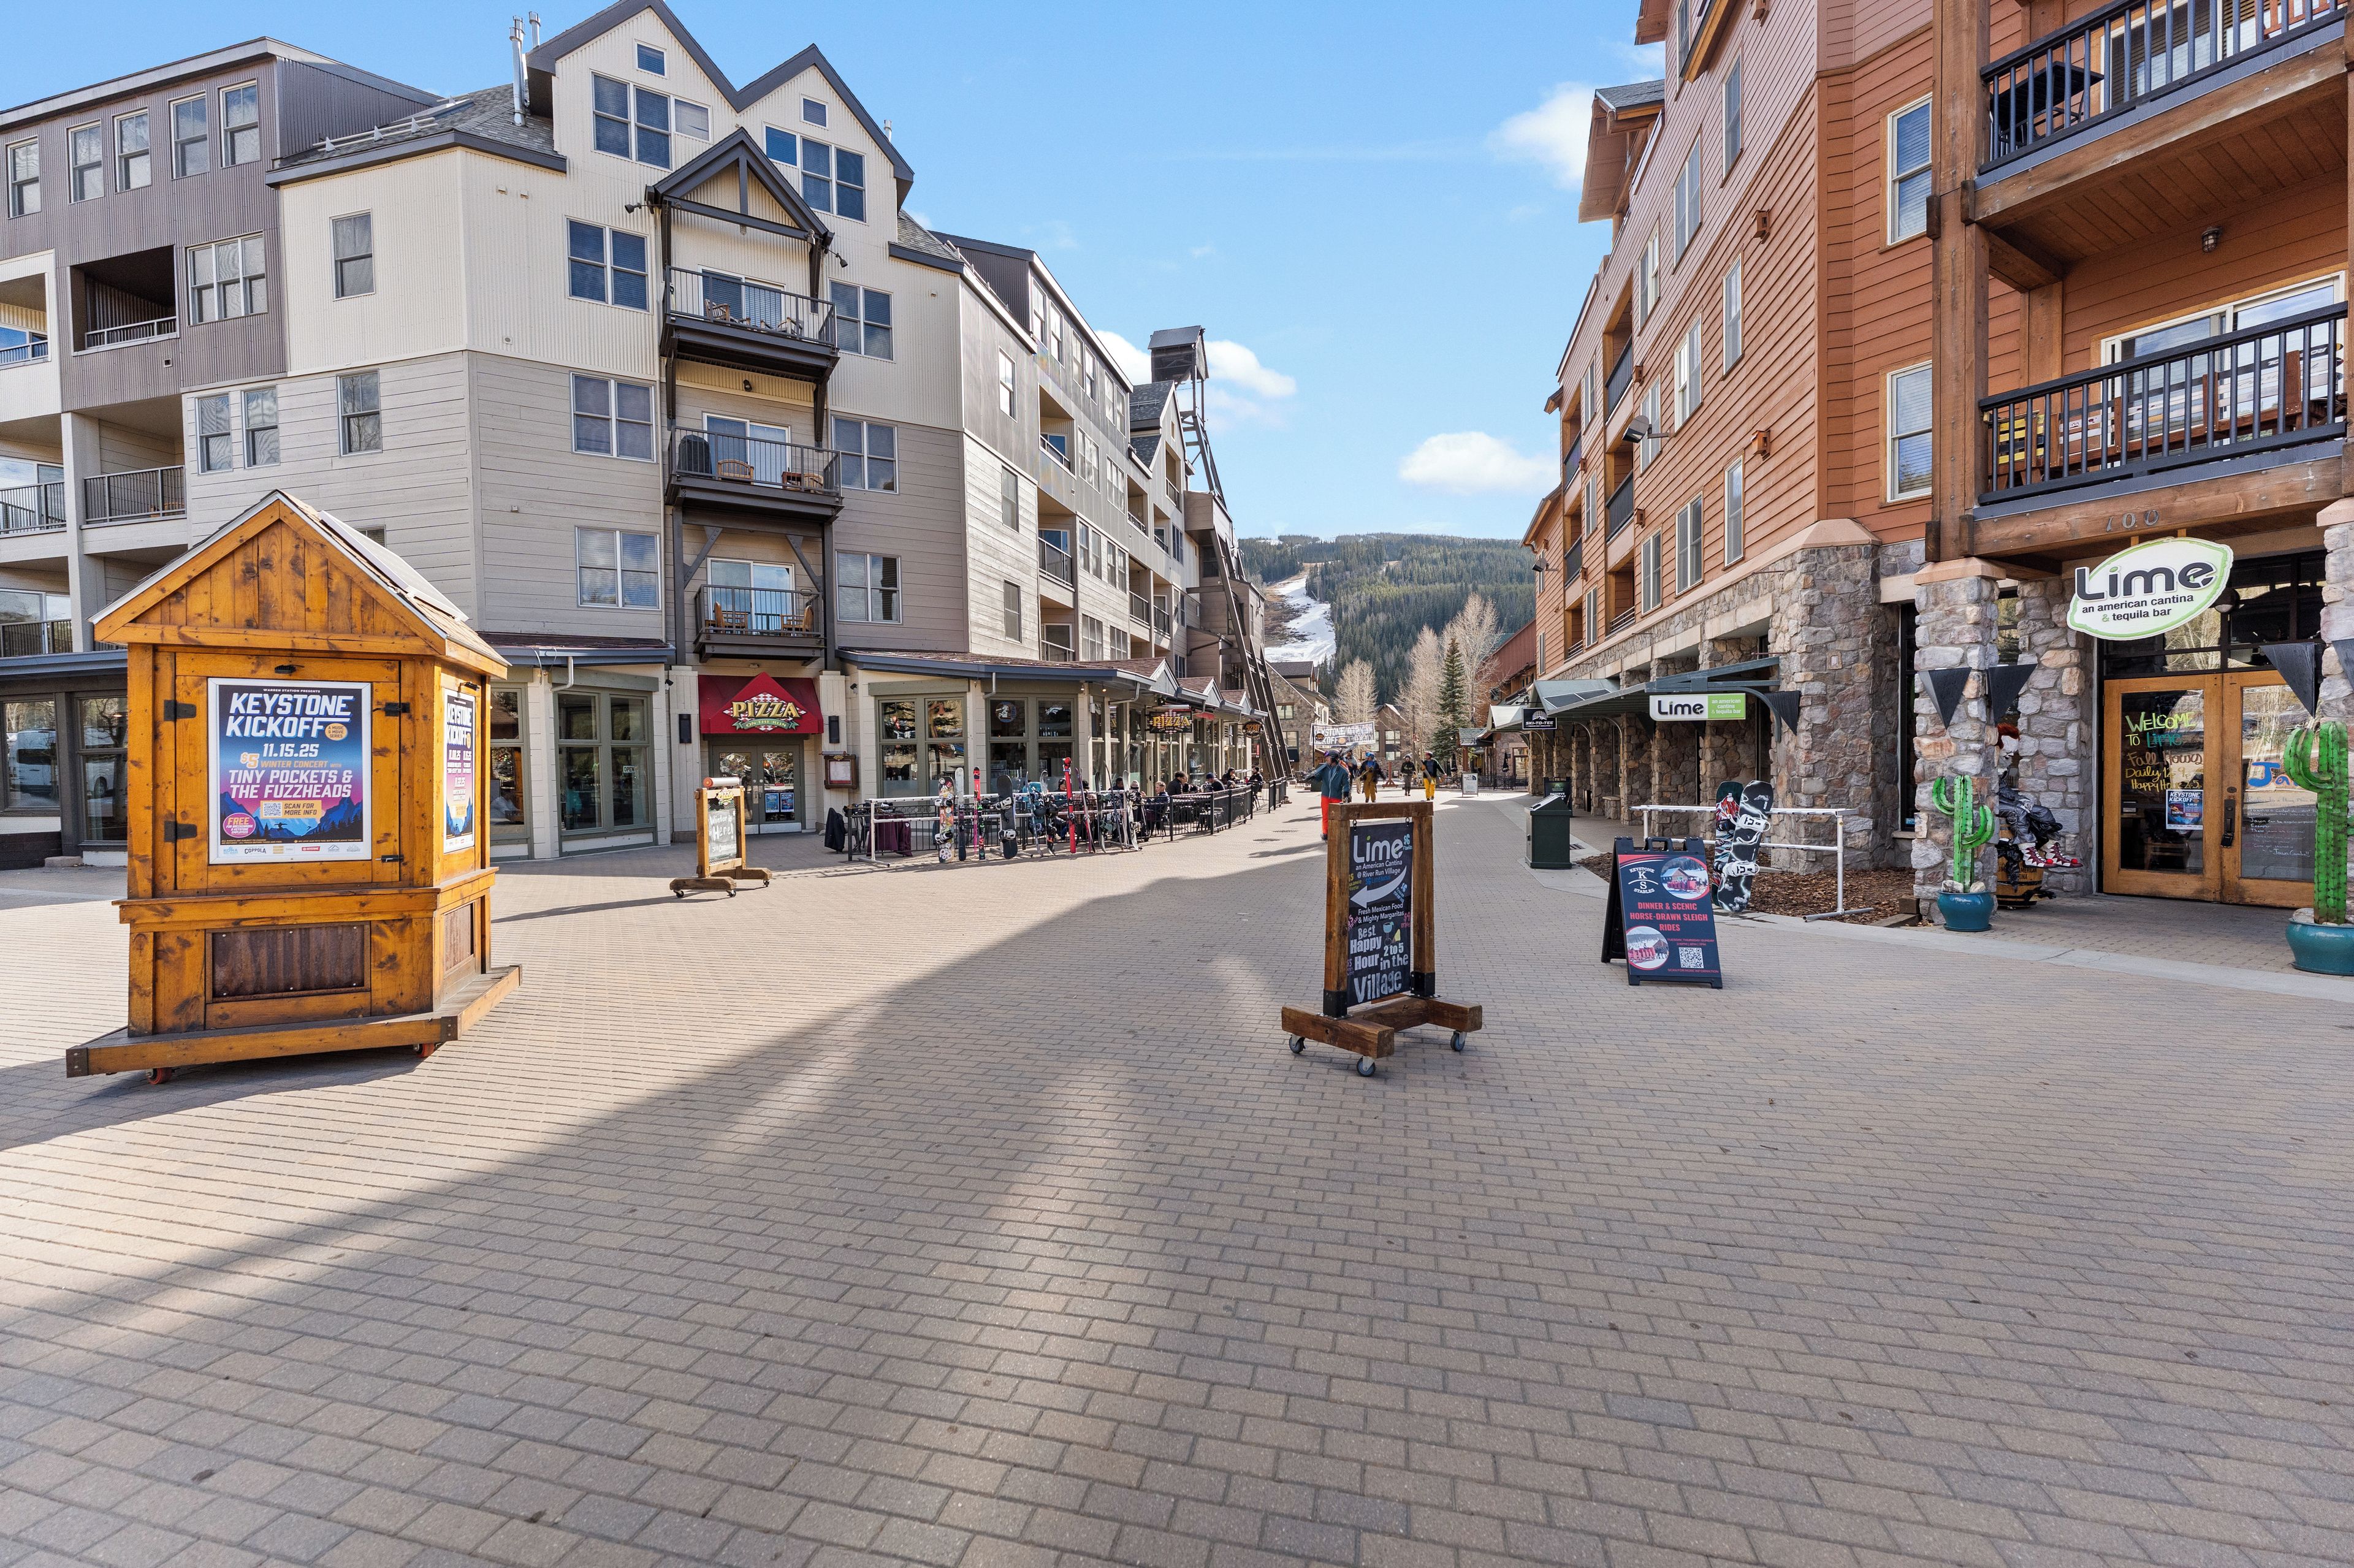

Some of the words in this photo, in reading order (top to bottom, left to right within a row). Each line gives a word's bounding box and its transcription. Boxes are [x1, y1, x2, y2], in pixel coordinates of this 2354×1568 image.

[2106, 509, 2159, 532] 100
[2076, 561, 2217, 601] Lime
[2082, 605, 2094, 614] an
[2098, 599, 2147, 612] american
[2150, 594, 2193, 606] cantina
[2101, 614, 2109, 622] &
[2112, 611, 2149, 622] tequila
[2153, 607, 2171, 617] bar
[229, 692, 354, 716] KEYSTONE
[732, 701, 801, 718] PIZZA
[1658, 700, 1704, 715] Lime
[447, 702, 473, 727] KEYSTONE
[1152, 716, 1190, 726] PIZZA
[2125, 712, 2196, 733] WELCOME
[226, 716, 351, 738] KICKOFF
[2125, 733, 2141, 746] TO
[2147, 732, 2183, 748] Lime
[263, 743, 319, 758] 11.15.25
[2126, 752, 2160, 767] Fall
[2163, 750, 2204, 766] Hours
[240, 752, 260, 769] $5
[229, 769, 265, 784] TINY
[269, 769, 338, 784] POCKETS
[341, 770, 353, 783] &
[2125, 766, 2162, 782] Daily
[230, 784, 260, 799] THE
[264, 784, 352, 799] FUZZHEADS
[2131, 778, 2160, 793] Happy
[709, 815, 728, 825] Winter
[712, 823, 734, 841] Here!
[1353, 835, 1403, 863] Lime
[1362, 860, 1385, 870] American
[1640, 881, 1647, 889] S
[1358, 907, 1371, 916] Fresh
[1371, 905, 1391, 913] Mexican
[1363, 915, 1379, 924] Mighty
[1380, 910, 1404, 920] Margaritas
[1629, 912, 1682, 921] HORSE-DRAWN
[1357, 924, 1376, 940] Best
[1659, 923, 1681, 932] RIDES
[1350, 935, 1382, 954] Happy
[1383, 945, 1389, 957] 2
[1389, 945, 1398, 954] to
[1398, 942, 1404, 954] 5
[1354, 953, 1379, 971] Hour
[1380, 957, 1390, 971] in
[1392, 953, 1409, 967] the
[1354, 970, 1402, 1003] Village
